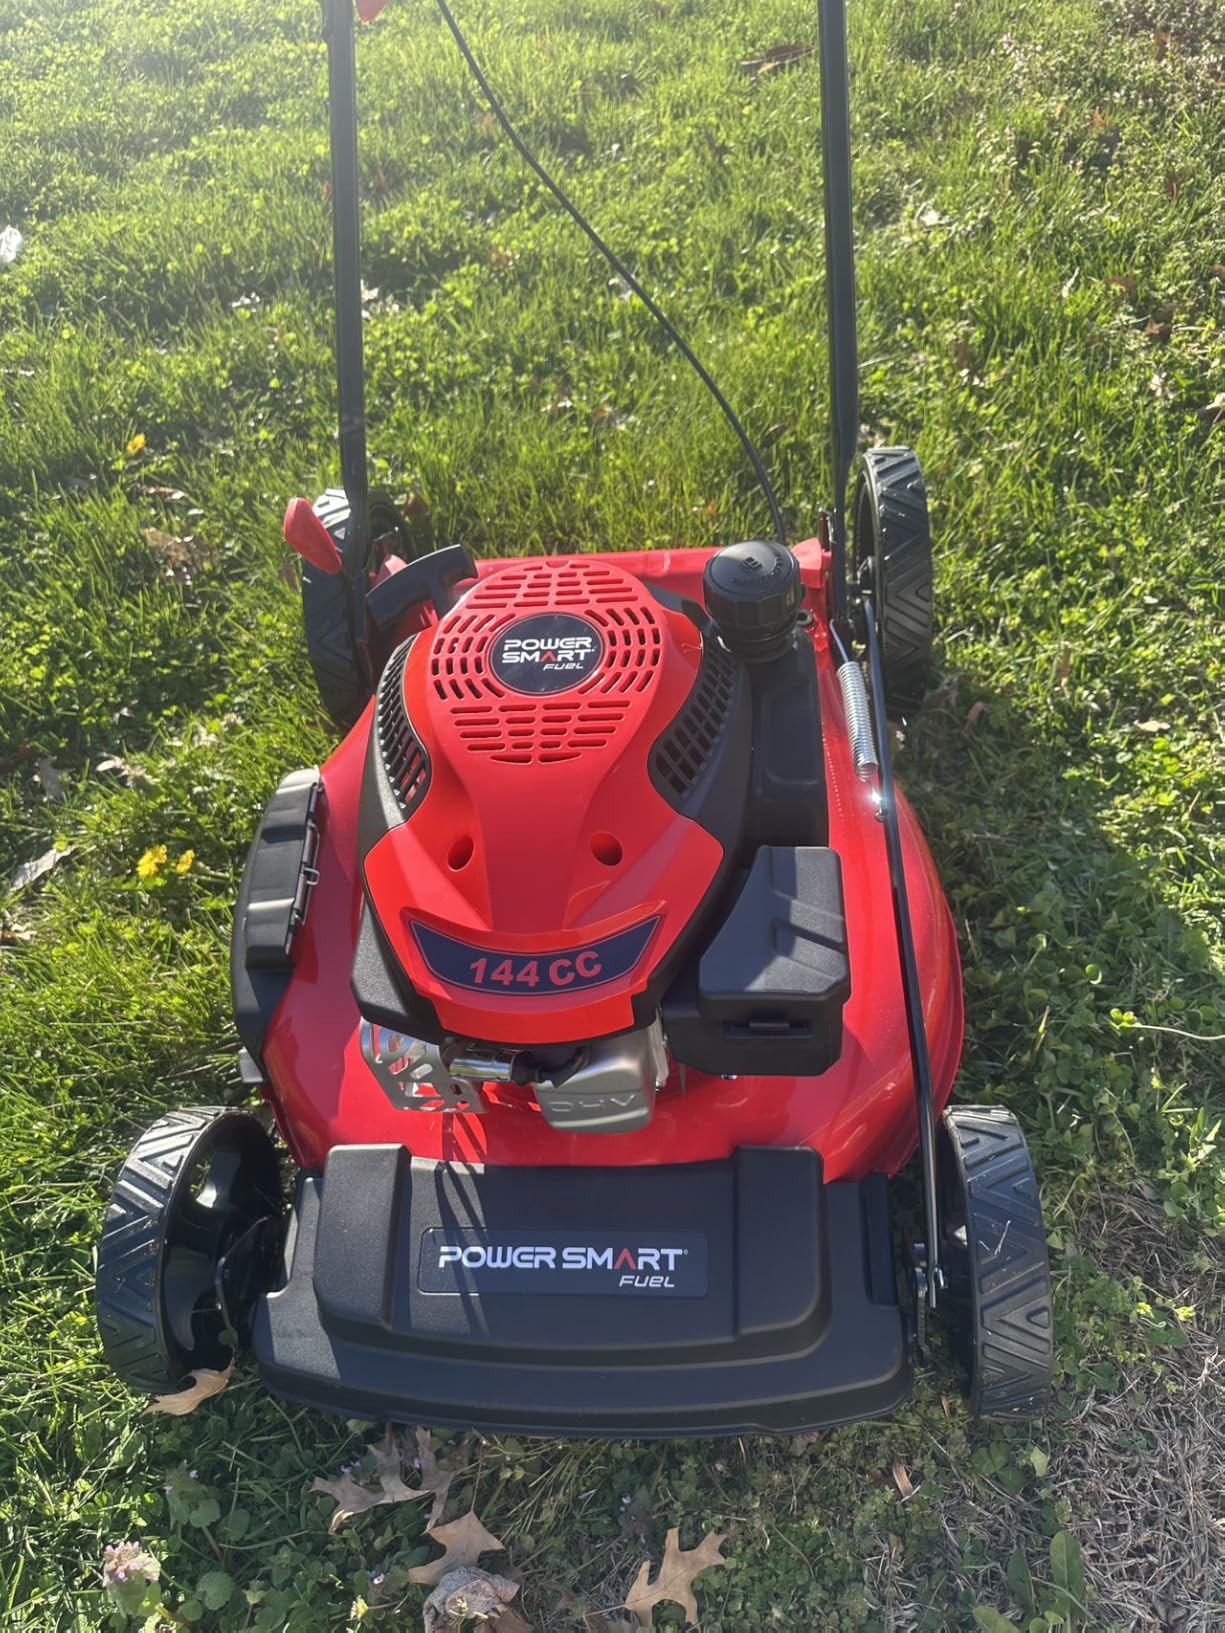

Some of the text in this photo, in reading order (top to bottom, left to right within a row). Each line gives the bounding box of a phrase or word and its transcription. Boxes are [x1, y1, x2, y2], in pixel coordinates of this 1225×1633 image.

[503, 637, 592, 651] POWER
[502, 649, 593, 664] SMART
[543, 662, 584, 671] FUEL
[470, 951, 602, 987] 144 CC
[439, 1246, 683, 1271] POWER SMART
[619, 1275, 675, 1288] FUEL
